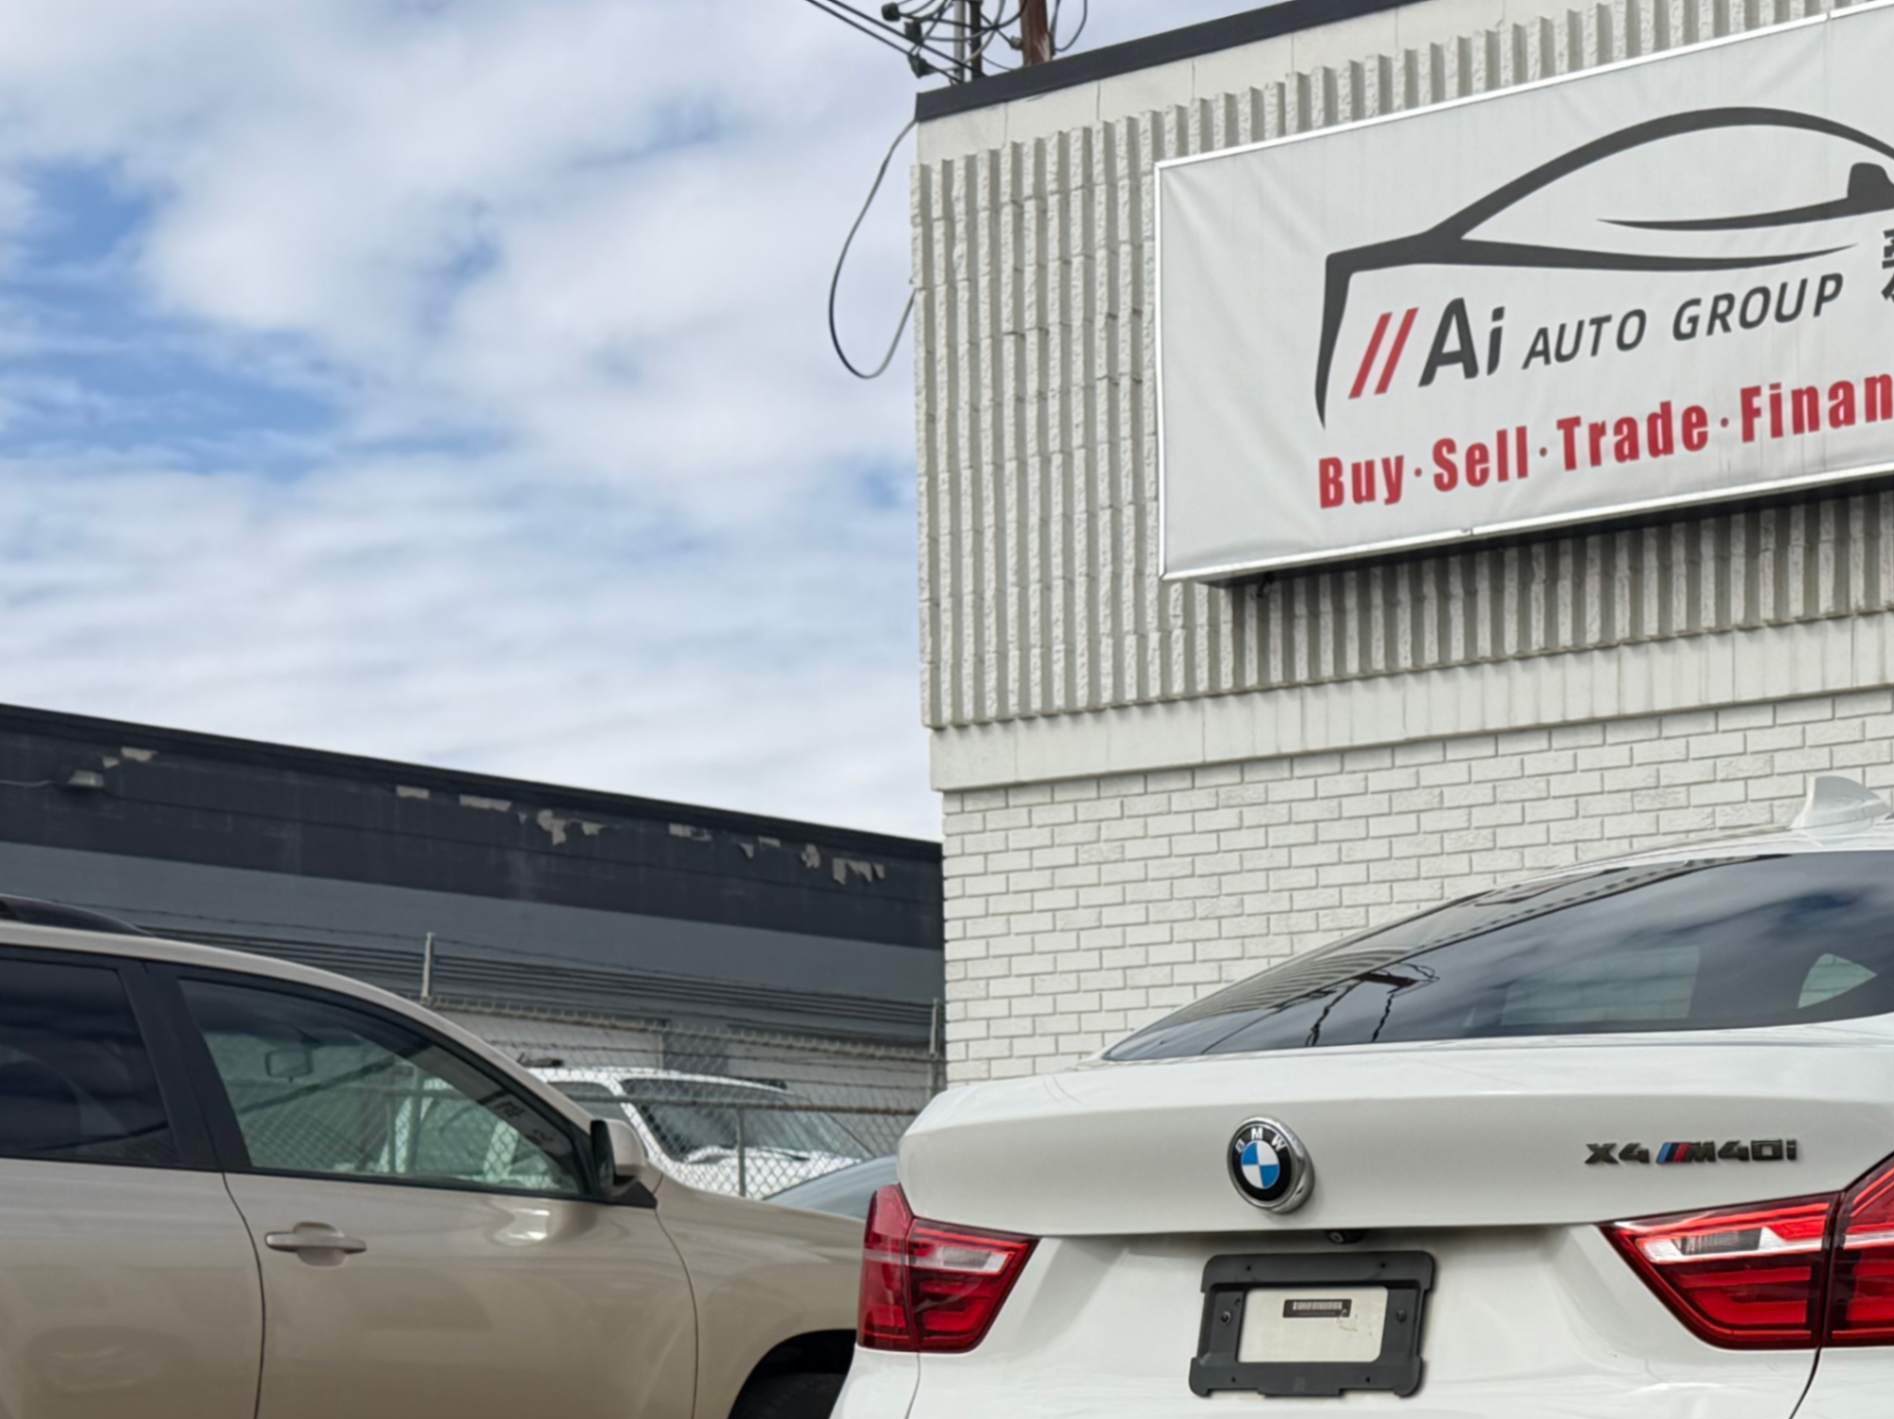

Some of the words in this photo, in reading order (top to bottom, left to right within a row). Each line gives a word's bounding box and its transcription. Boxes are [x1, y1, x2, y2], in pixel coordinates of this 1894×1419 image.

[1417, 296, 1506, 387] Ai
[1521, 308, 1647, 370] AUTO
[1671, 272, 1844, 341] GROUP
[1318, 454, 1405, 509] Buy
[1432, 425, 1529, 492] Sell
[1556, 400, 1709, 472] Trade
[1234, 1126, 1289, 1154] BMW
[1584, 1142, 1651, 1165] X4
